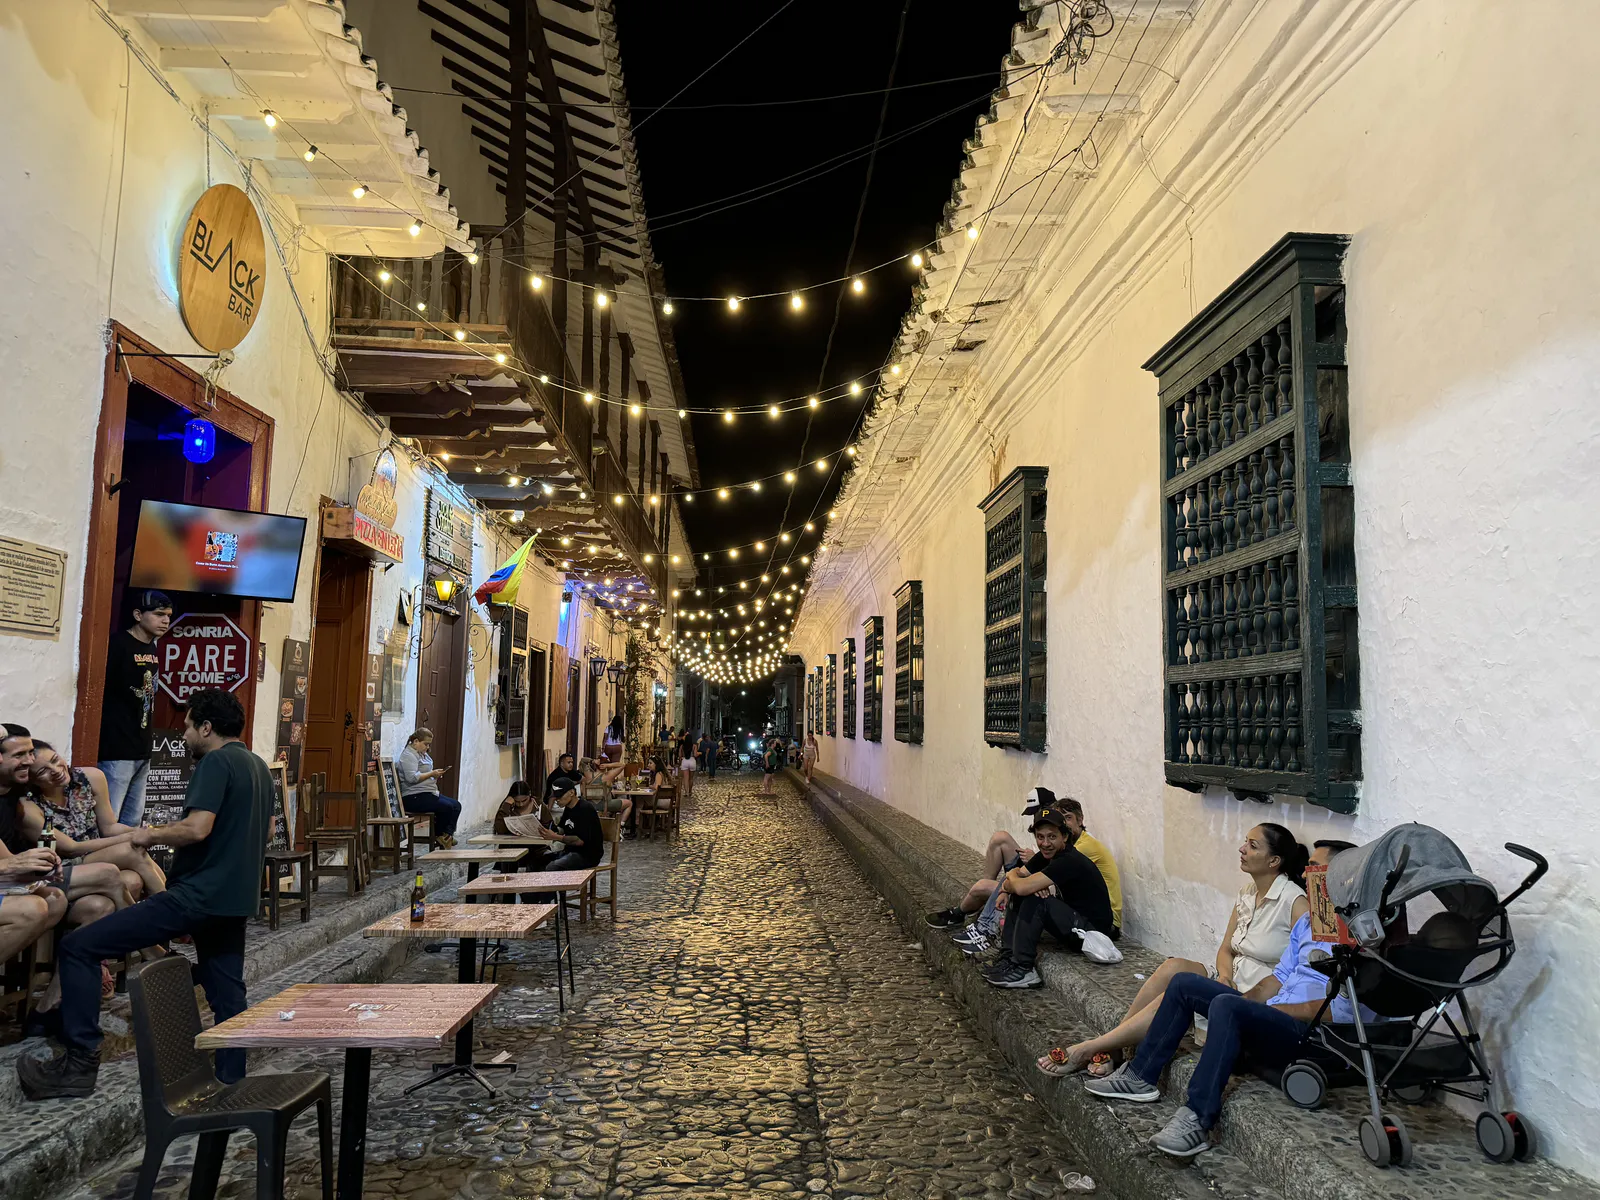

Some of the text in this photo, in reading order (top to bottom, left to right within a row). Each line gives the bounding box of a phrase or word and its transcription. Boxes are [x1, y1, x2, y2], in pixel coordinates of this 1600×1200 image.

[190, 219, 260, 307] BLACK
[227, 293, 252, 325] BAR
[354, 516, 377, 546] PIZZA
[172, 625, 233, 638] SONRIA
[164, 643, 237, 672] PARE
[161, 671, 174, 685] Y
[177, 671, 225, 684] TOME
[152, 737, 186, 752] LACK
[1042, 809, 1050, 818] P
